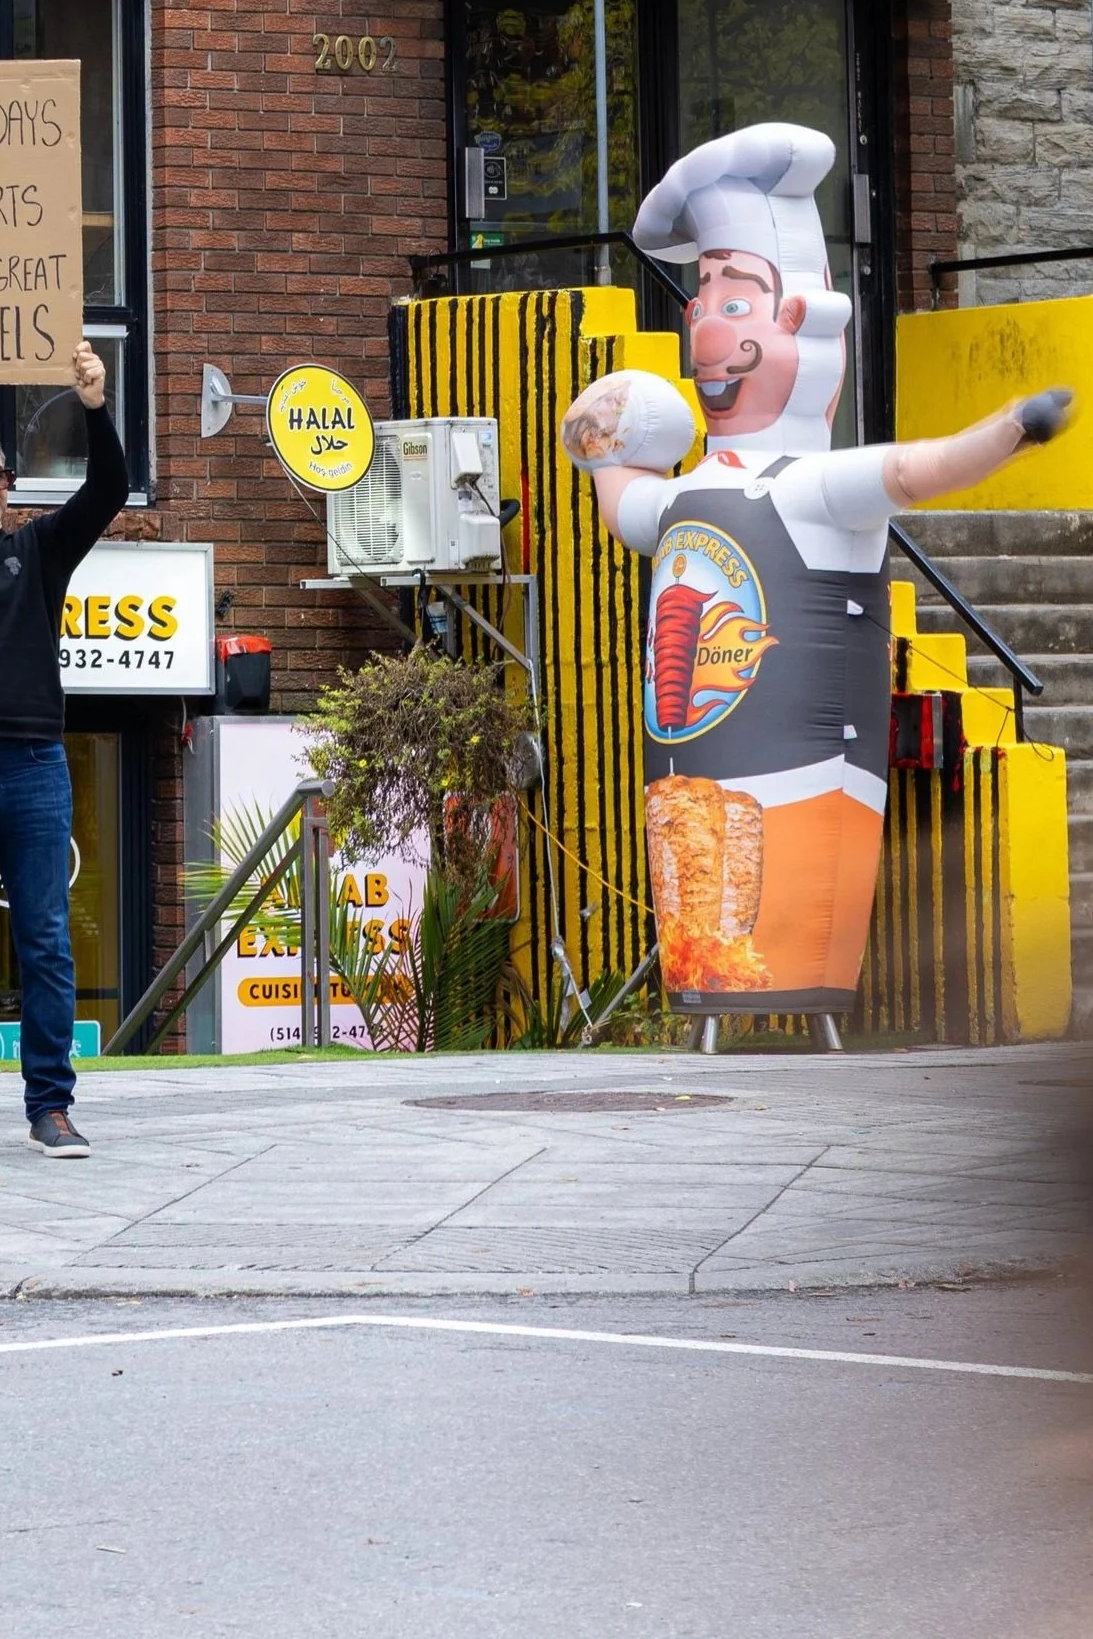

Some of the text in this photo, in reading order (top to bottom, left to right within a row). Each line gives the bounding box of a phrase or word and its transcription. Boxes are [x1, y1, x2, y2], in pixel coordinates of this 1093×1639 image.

[313, 33, 397, 72] 2002
[289, 407, 355, 430] HALAL
[310, 434, 349, 456] حلال
[402, 441, 428, 456] Gibson
[674, 529, 750, 589] EXPRESS
[59, 594, 179, 642] RESS
[59, 648, 175, 670] 932-4747
[696, 645, 755, 667] Döner
[249, 981, 319, 1000] CUISI
[269, 1026, 302, 1042] (514
